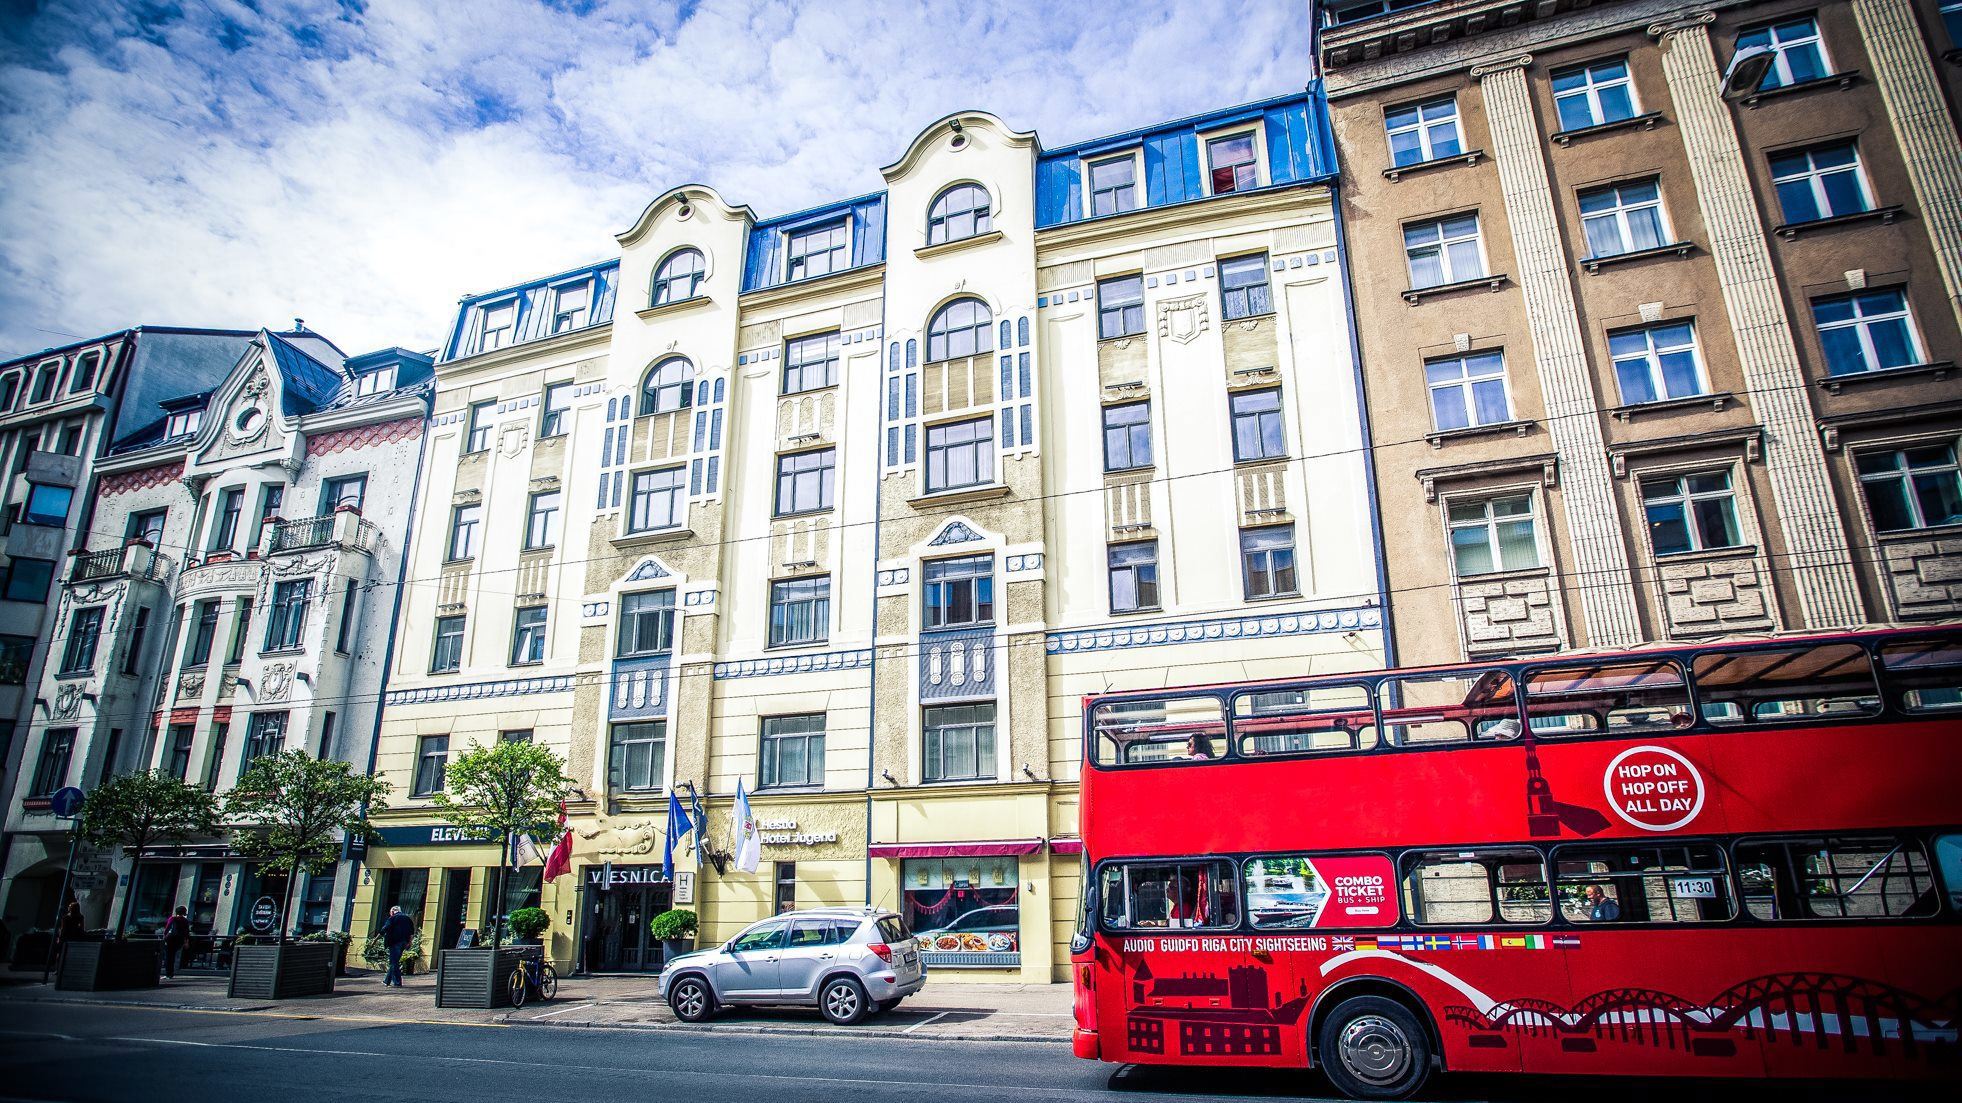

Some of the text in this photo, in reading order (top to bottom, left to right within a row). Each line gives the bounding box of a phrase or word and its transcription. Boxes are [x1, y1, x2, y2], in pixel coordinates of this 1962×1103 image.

[1618, 763, 1677, 778] HOP ON
[1621, 780, 1688, 795] HOP OFF
[1626, 798, 1691, 813] ALL DAY
[760, 830, 837, 846] Hotel Jugend
[591, 868, 671, 884] VESNĪCA
[679, 874, 688, 886] H
[1334, 875, 1383, 887] COMBO
[1335, 885, 1385, 897] TICKET
[1677, 881, 1712, 894] 11:30
[1337, 896, 1355, 904] BUS
[1123, 938, 1155, 953] AUDIO
[1202, 938, 1228, 952] RIGA
[1229, 938, 1253, 952] CITY
[1255, 937, 1327, 951] SIGHTSEEING
